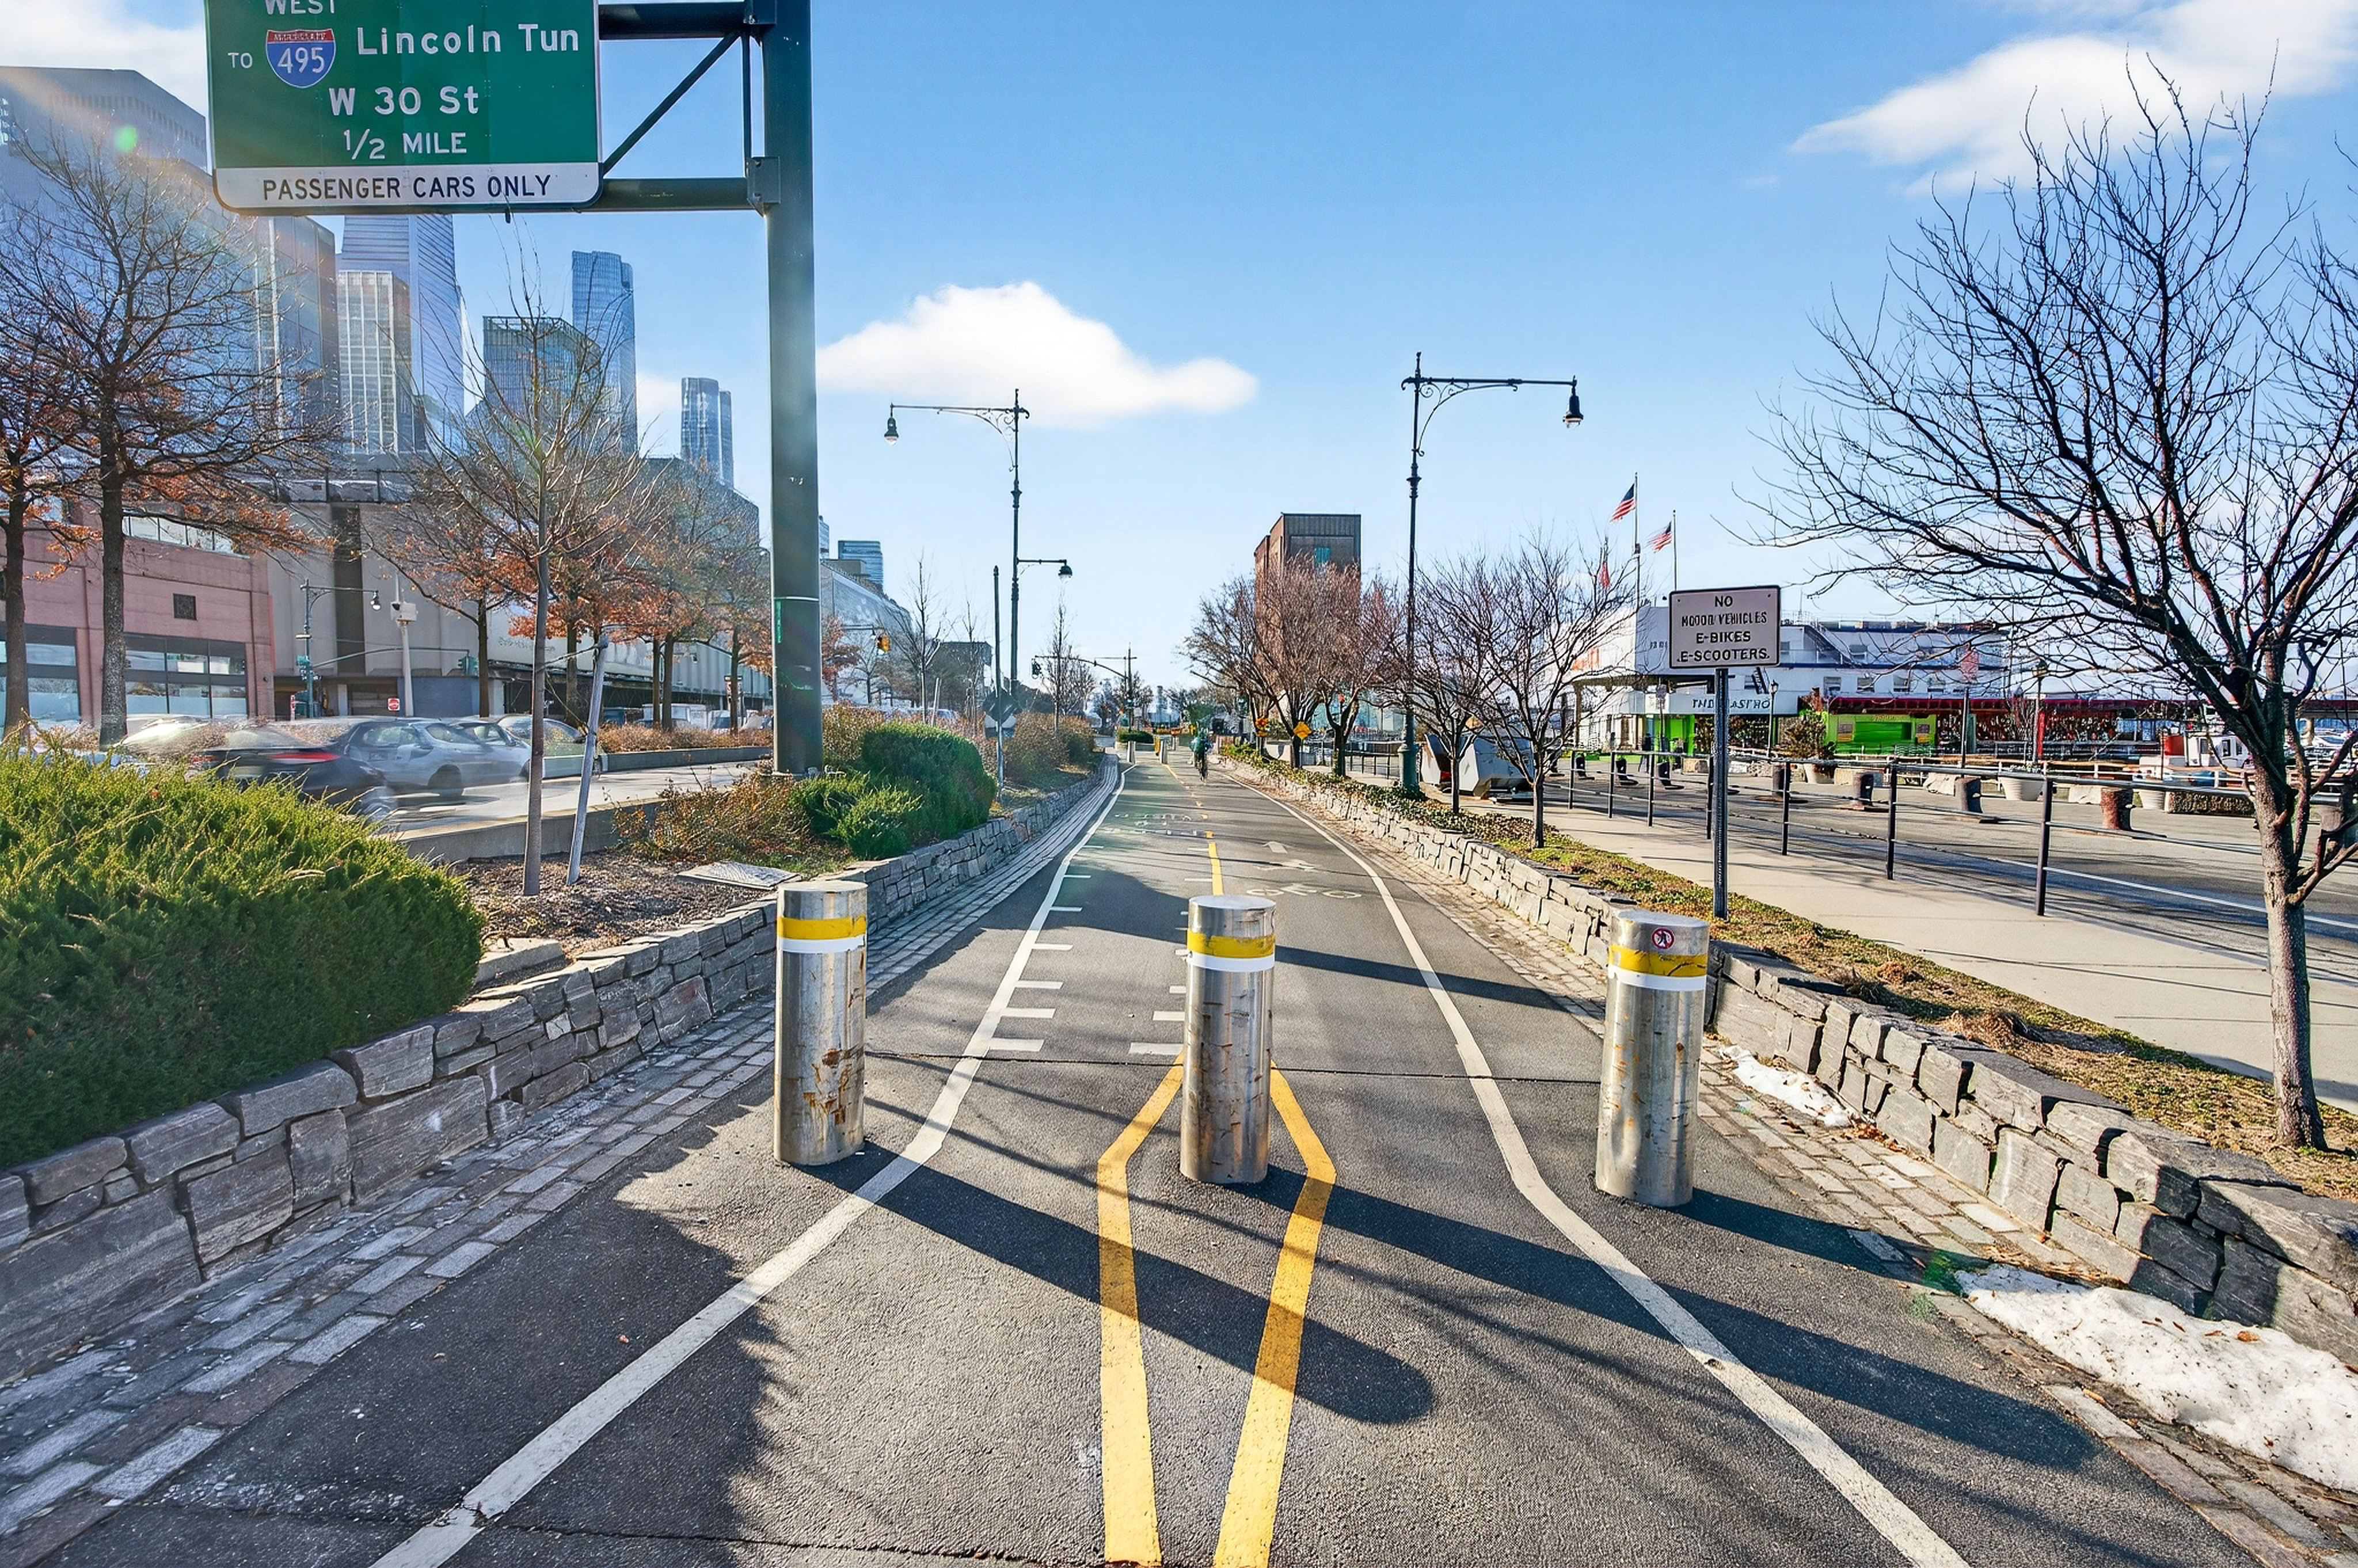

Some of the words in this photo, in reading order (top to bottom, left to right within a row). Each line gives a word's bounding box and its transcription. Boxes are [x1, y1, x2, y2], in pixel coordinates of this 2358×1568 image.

[265, 0, 335, 14] WEST
[357, 24, 501, 55] Lincoln
[518, 24, 579, 52] Tun
[227, 52, 253, 69] TO
[277, 47, 325, 74] 495
[329, 87, 355, 116] W
[374, 86, 421, 115] 30
[439, 86, 478, 114] St
[344, 128, 385, 159] 1/2
[402, 132, 467, 154] MILE
[263, 178, 401, 200] PASSENGER
[412, 176, 476, 199] CARS
[487, 174, 551, 197] ONLY
[1714, 596, 1733, 607] NO
[1696, 631, 1751, 644] E-BIKES
